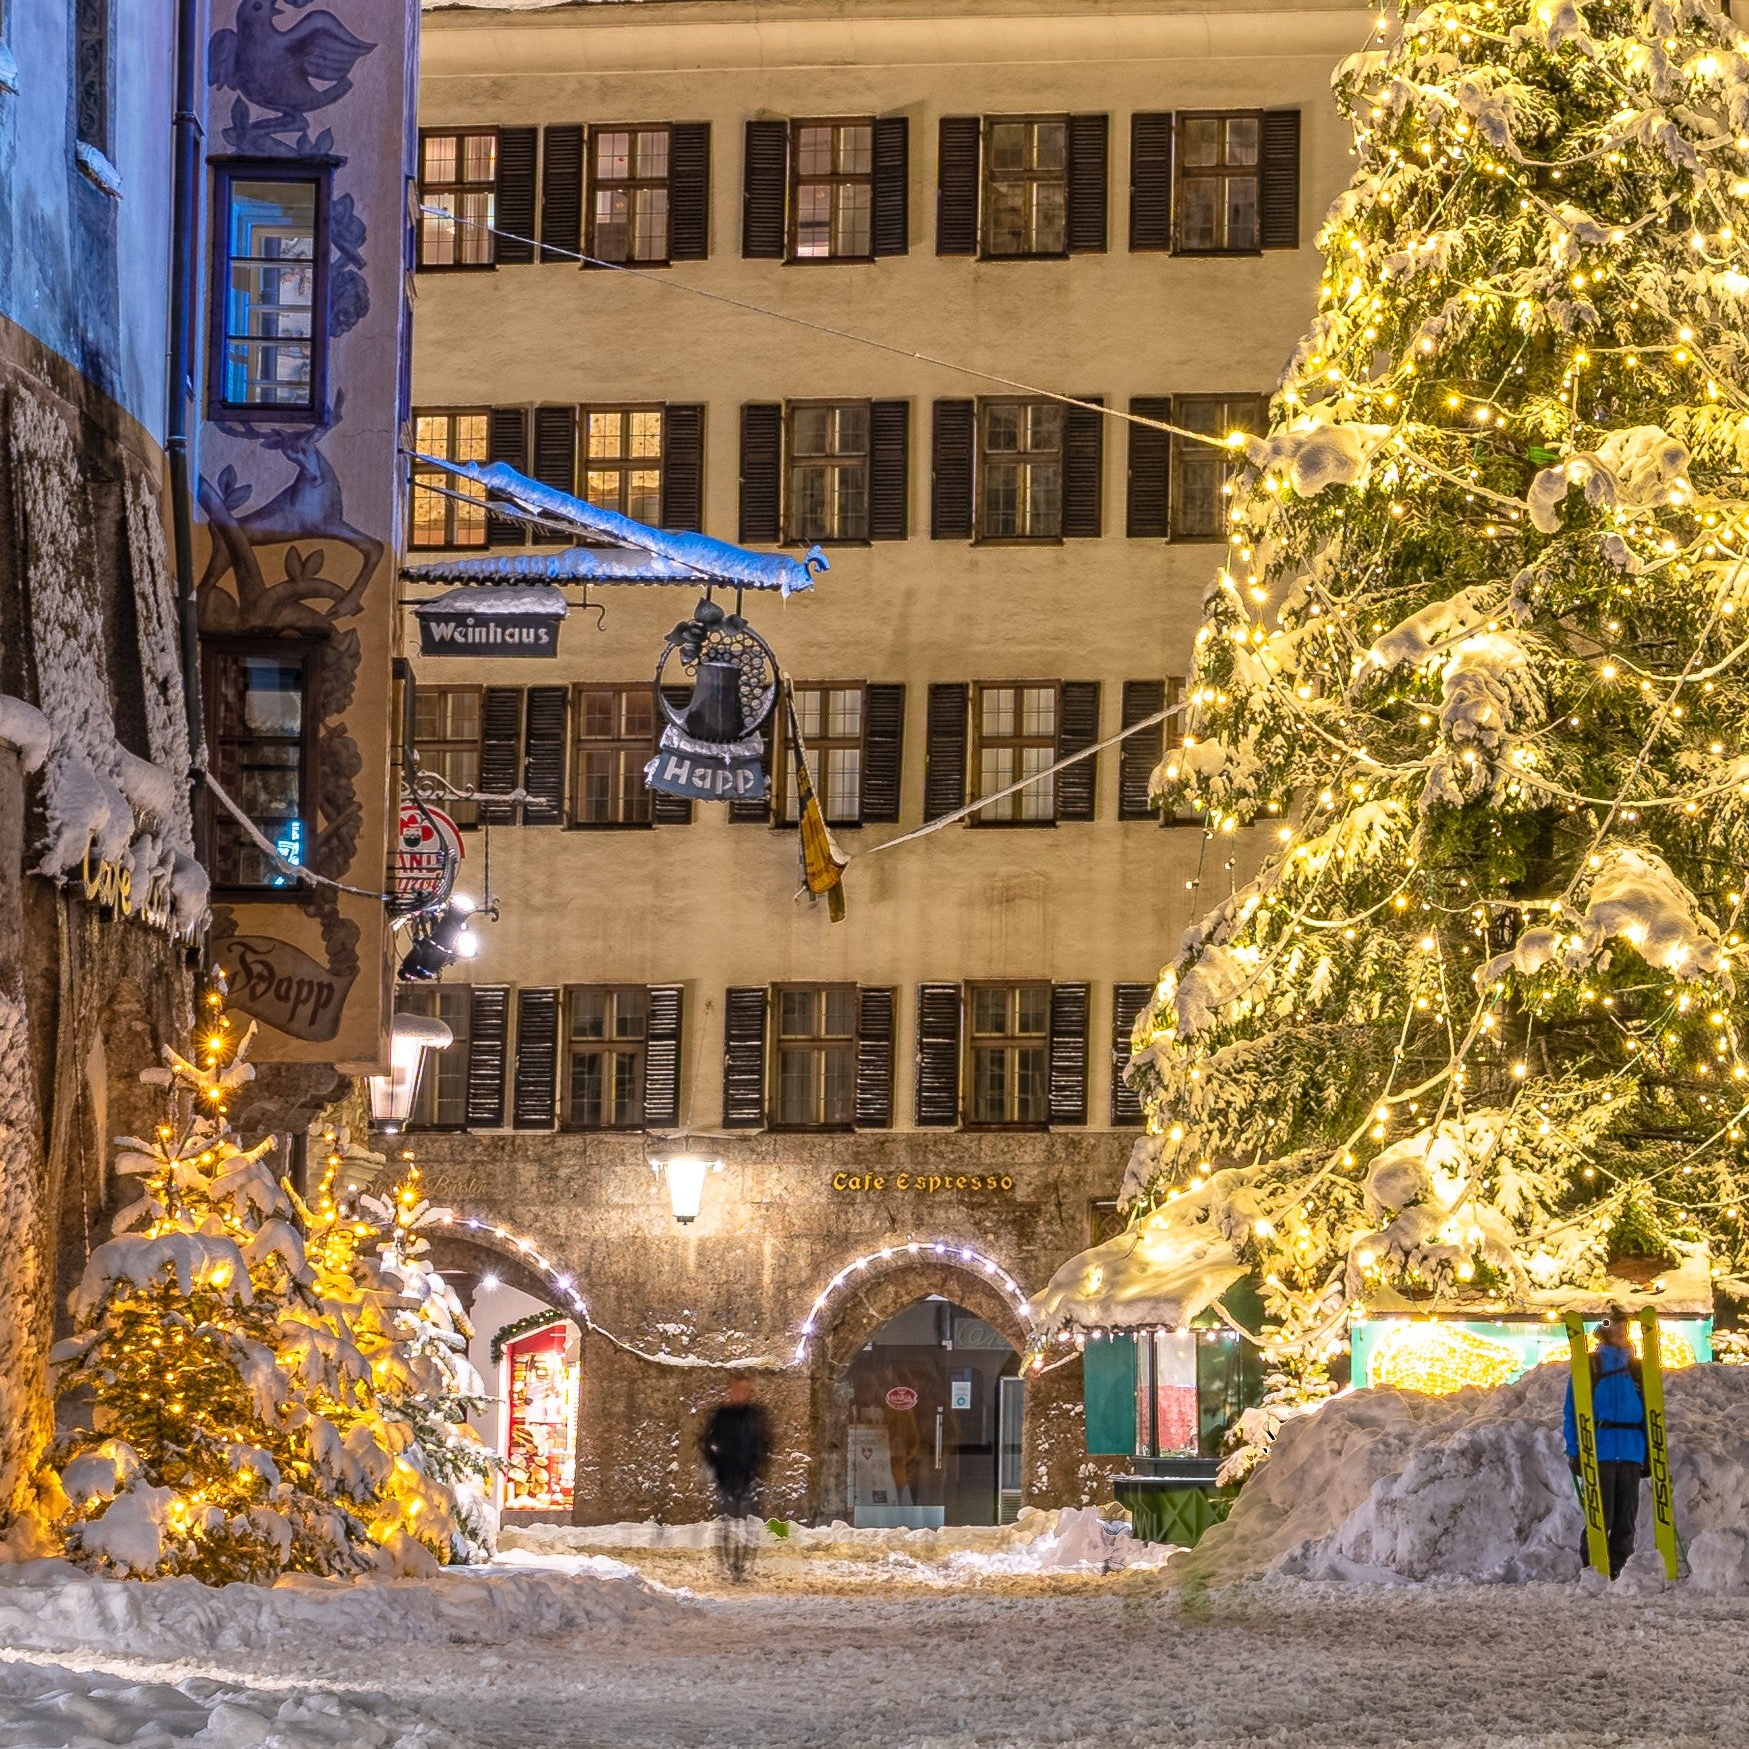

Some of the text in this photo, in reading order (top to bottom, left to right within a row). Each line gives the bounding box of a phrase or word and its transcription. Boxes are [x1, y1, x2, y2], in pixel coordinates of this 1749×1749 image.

[429, 617, 550, 644] Weinhaus
[662, 756, 755, 794] Happ
[833, 1171, 1013, 1193] Cafe Espresso
[1579, 1412, 1602, 1532] FISCHER
[1649, 1408, 1671, 1528] FISCHER
